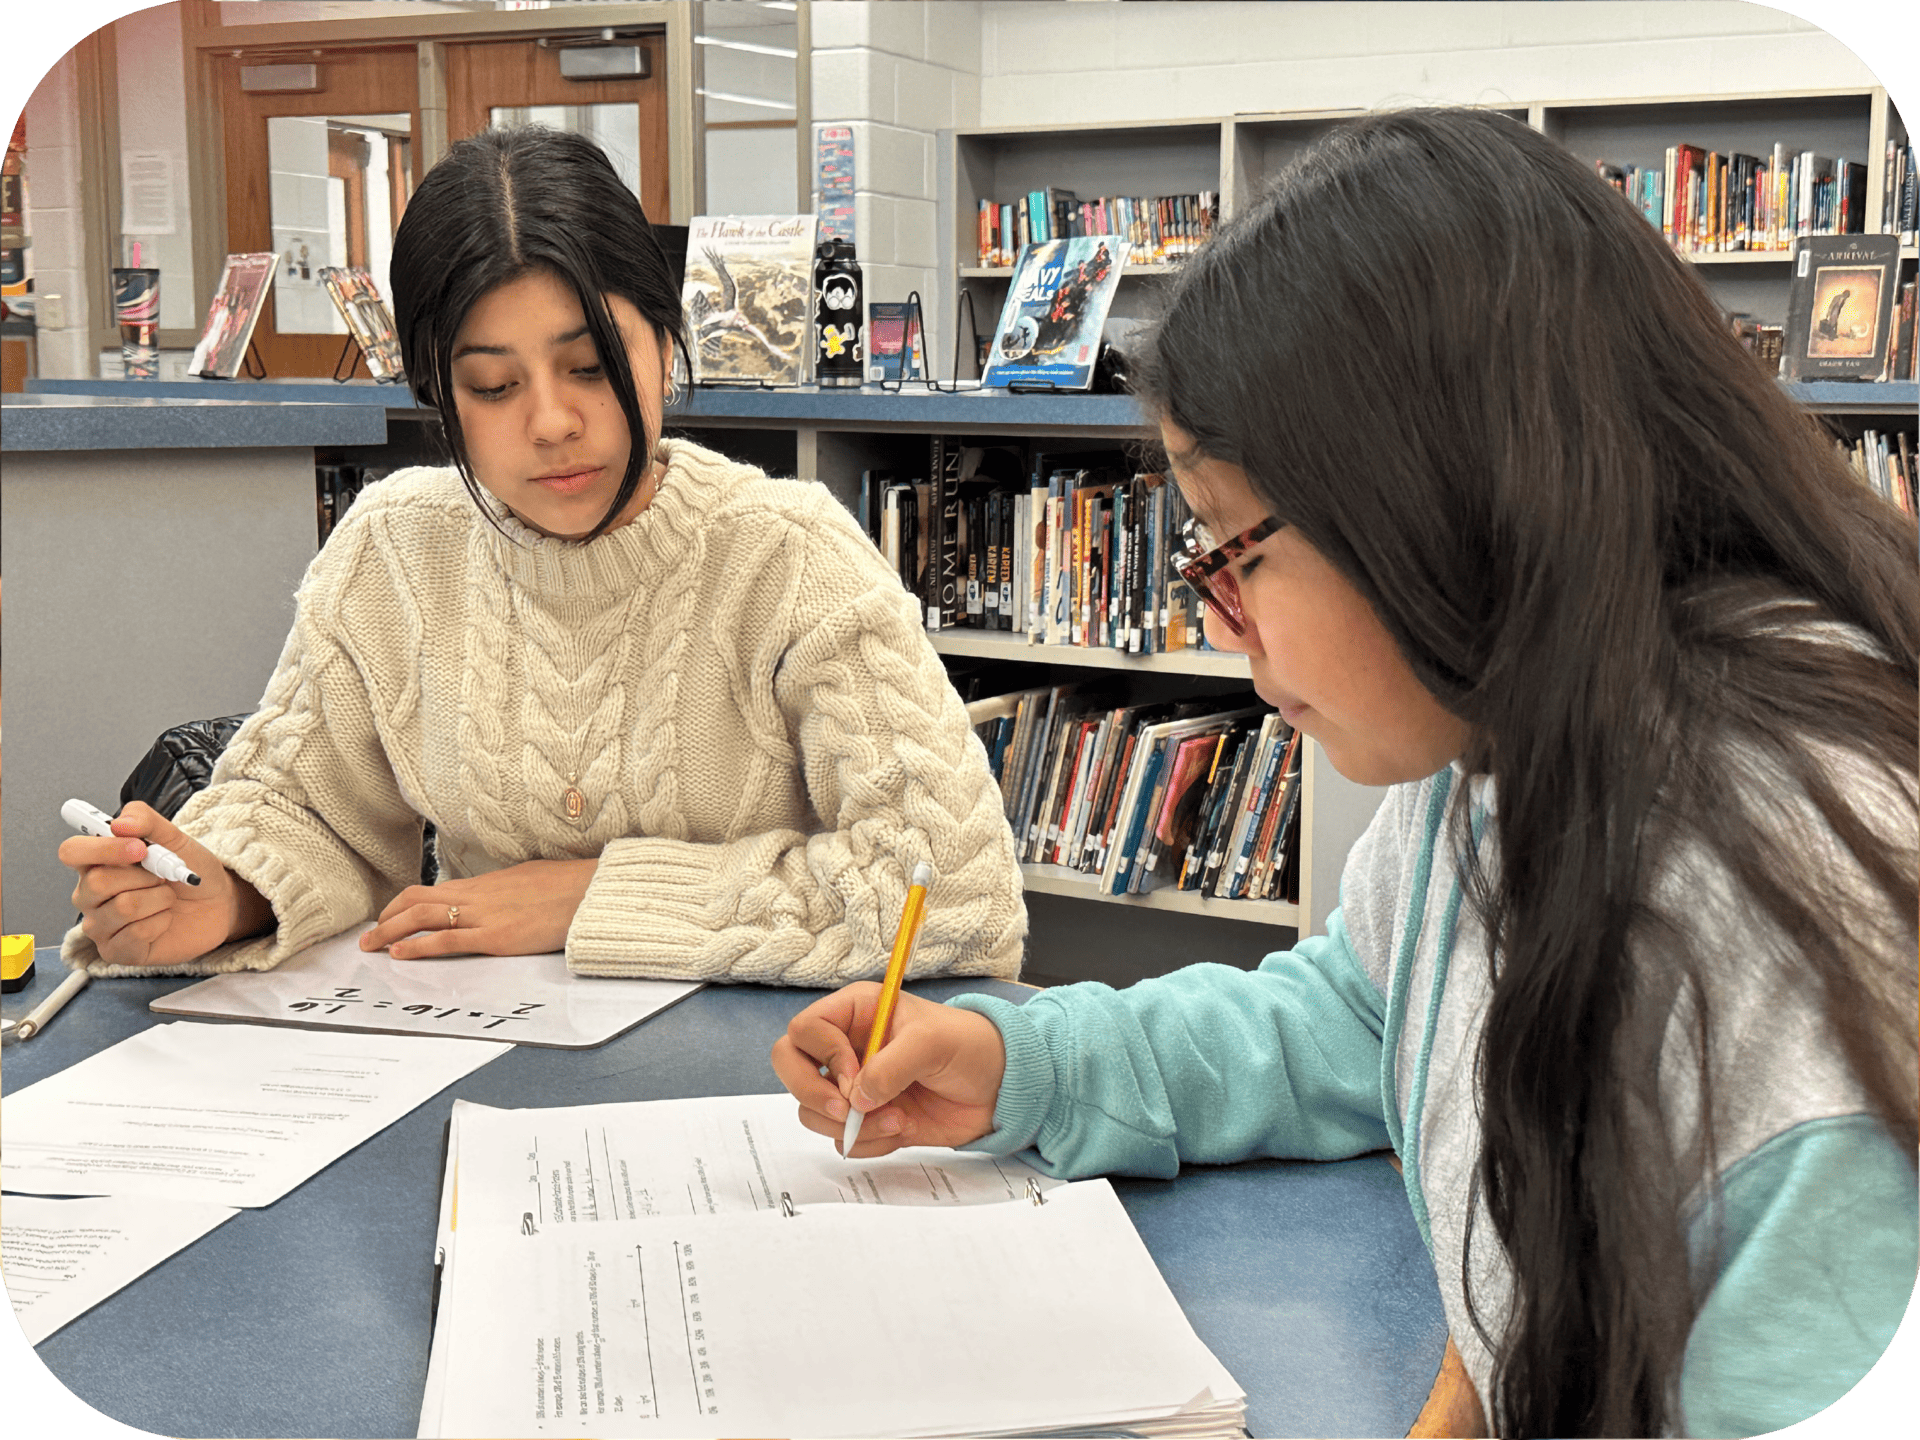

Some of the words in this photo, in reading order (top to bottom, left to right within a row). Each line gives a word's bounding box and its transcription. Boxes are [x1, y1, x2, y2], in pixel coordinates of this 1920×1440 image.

[696, 227, 709, 238] The
[710, 221, 745, 239] Hawk
[756, 227, 767, 238] the
[768, 219, 806, 238] Castle
[943, 451, 959, 518] RUN
[986, 545, 997, 584] KAREEM
[940, 532, 956, 628] HOME
[334, 987, 362, 998] 2
[288, 1001, 347, 1014] 1.6
[401, 1003, 461, 1019] 1.6
[512, 1002, 546, 1015] 2
